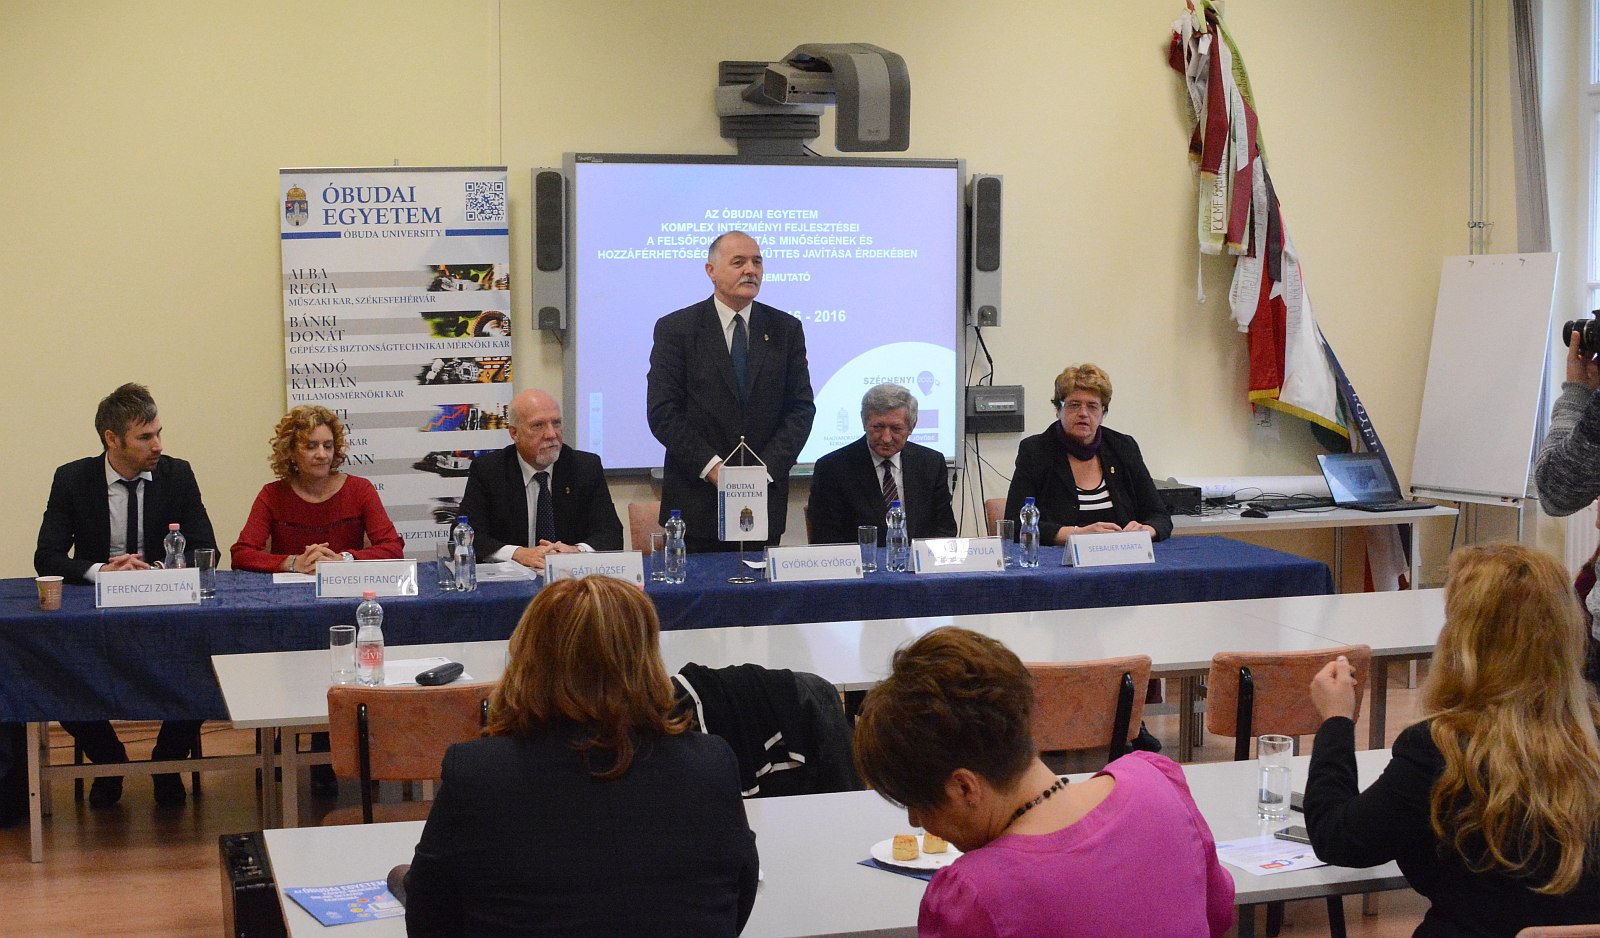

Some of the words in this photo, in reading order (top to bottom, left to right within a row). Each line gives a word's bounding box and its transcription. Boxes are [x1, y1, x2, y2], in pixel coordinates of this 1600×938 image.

[322, 183, 416, 205] ÓBUDAI
[322, 206, 442, 226] EGYETEM
[705, 209, 719, 219] AZ
[722, 207, 763, 219] ÓBUDAI
[767, 209, 818, 219] EGYETEM
[661, 222, 714, 232] KOMPLEX
[717, 220, 782, 232] INTÉZMÉNYI
[784, 221, 860, 232] FEJLESZTÉSEI
[344, 229, 379, 239] ÓBUDA
[381, 228, 442, 239] UNIVERSITY
[646, 236, 655, 246] A
[657, 235, 719, 246] FELSŐFOK
[779, 235, 856, 246] MINŐSÉGÉNEK
[859, 234, 873, 245] ÉS
[598, 248, 709, 259] HOZZÁFÉRHETŐSÉG
[760, 247, 800, 259] YÜTTES
[803, 247, 852, 259] JAVÍTÁSA
[855, 247, 918, 259] ÉRDEKÉBEN
[288, 268, 328, 280] ALBA
[289, 282, 338, 295] REGIA
[332, 297, 354, 306] KAR,
[355, 294, 436, 305] SZÉKESFEHÉRVÁR
[289, 313, 337, 328] BÁNKI
[814, 310, 846, 323] 2016
[290, 327, 346, 343] DONÁT
[289, 344, 327, 355] GÉPÉSZ
[327, 343, 339, 354] ÉS
[340, 341, 446, 353] BIZTONSÁGTECHNIKAI
[446, 339, 491, 350] MÉRNÖKI
[492, 339, 511, 349] KAR
[291, 359, 348, 375] KANDÓ
[291, 375, 358, 390] KÁLMÁN
[863, 375, 915, 385] SZÉCHENYI
[292, 389, 384, 401] VILLAMOSMÉRNÖKI
[385, 389, 404, 399] KAR
[349, 438, 368, 446] KAR
[726, 482, 755, 490] ÓBUDAI
[967, 547, 995, 556] GYULA
[1088, 545, 1120, 553] SEEBAUER
[1120, 543, 1143, 551] MÁRTA
[595, 564, 626, 575] JÓZSEF
[781, 558, 819, 570] GYÖRÖK
[821, 557, 857, 569] GYÖRGY
[106, 583, 154, 594] FERENCZI
[155, 580, 194, 593] ZOLTÁN
[322, 576, 361, 586] HEGYESI
